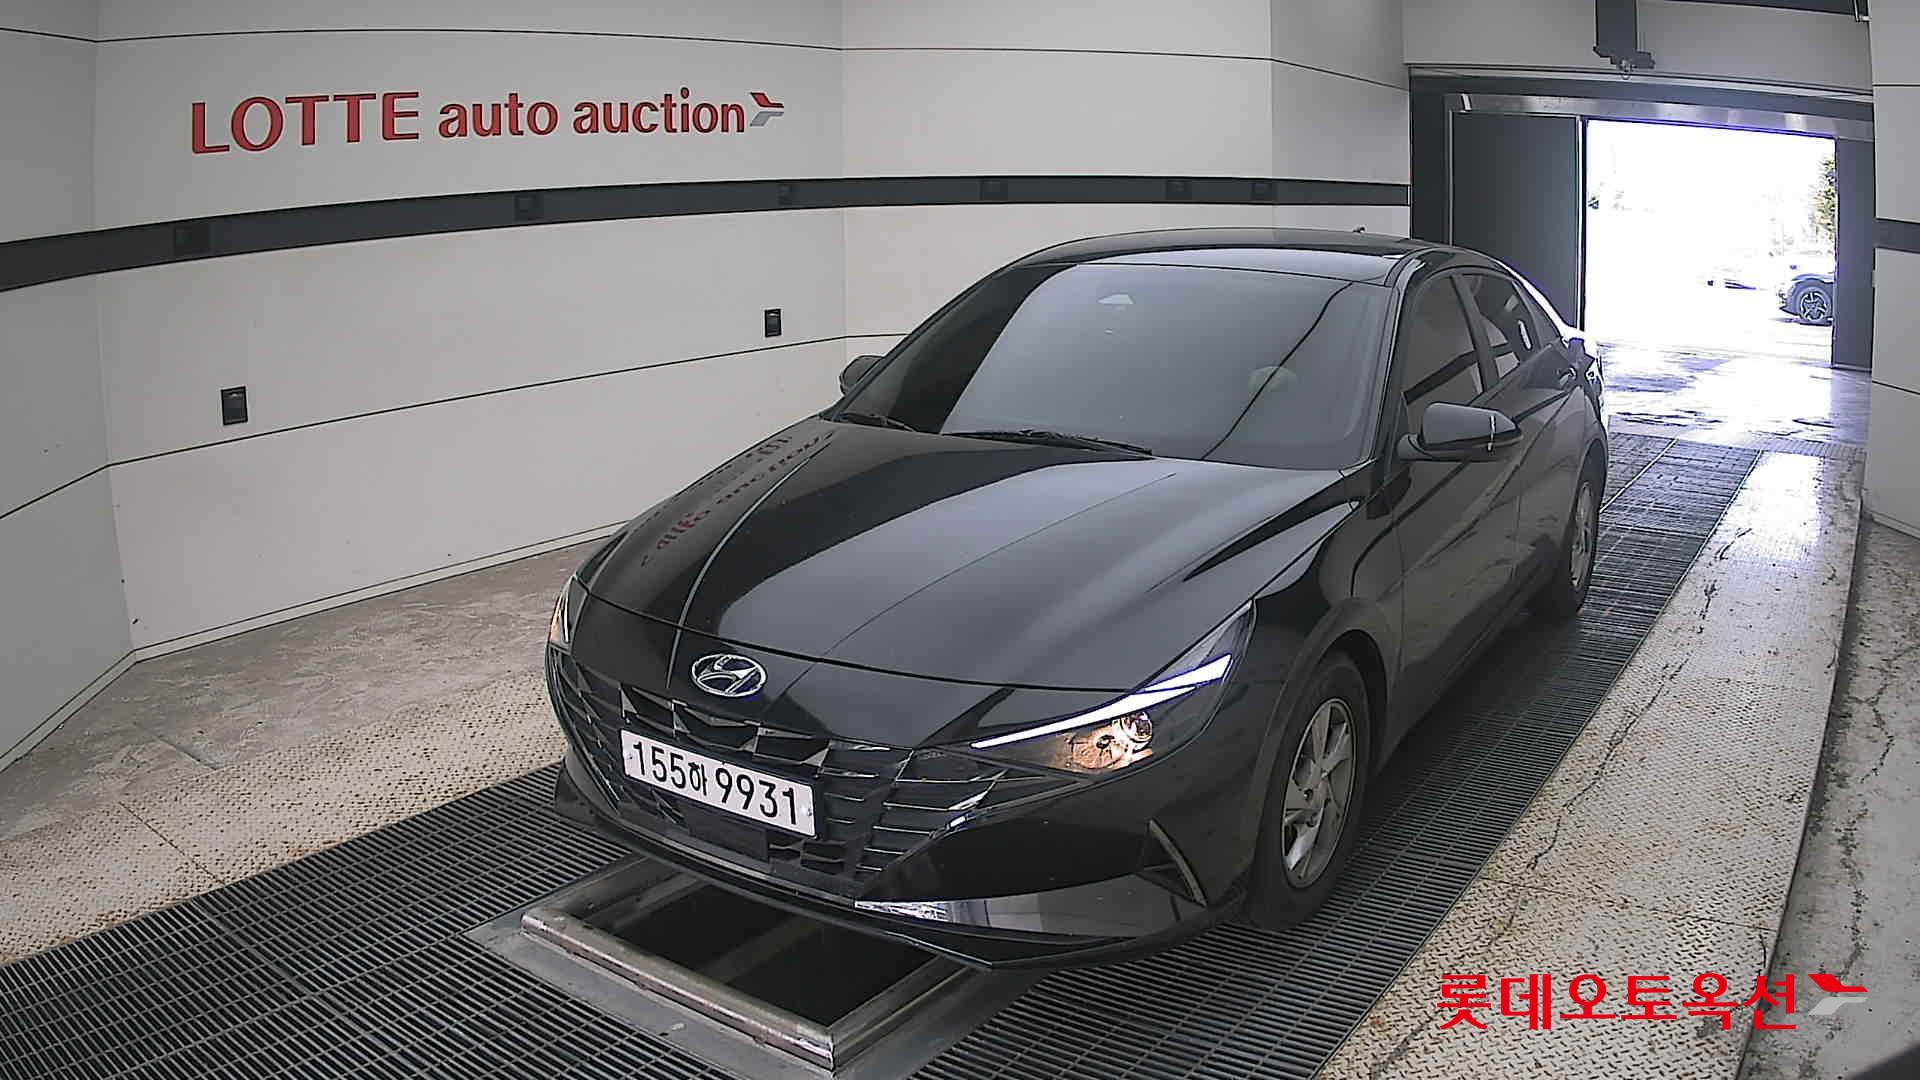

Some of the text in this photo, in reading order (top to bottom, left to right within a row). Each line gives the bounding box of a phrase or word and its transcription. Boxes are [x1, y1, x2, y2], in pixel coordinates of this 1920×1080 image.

[191, 87, 746, 155] LOTTE auto auction
